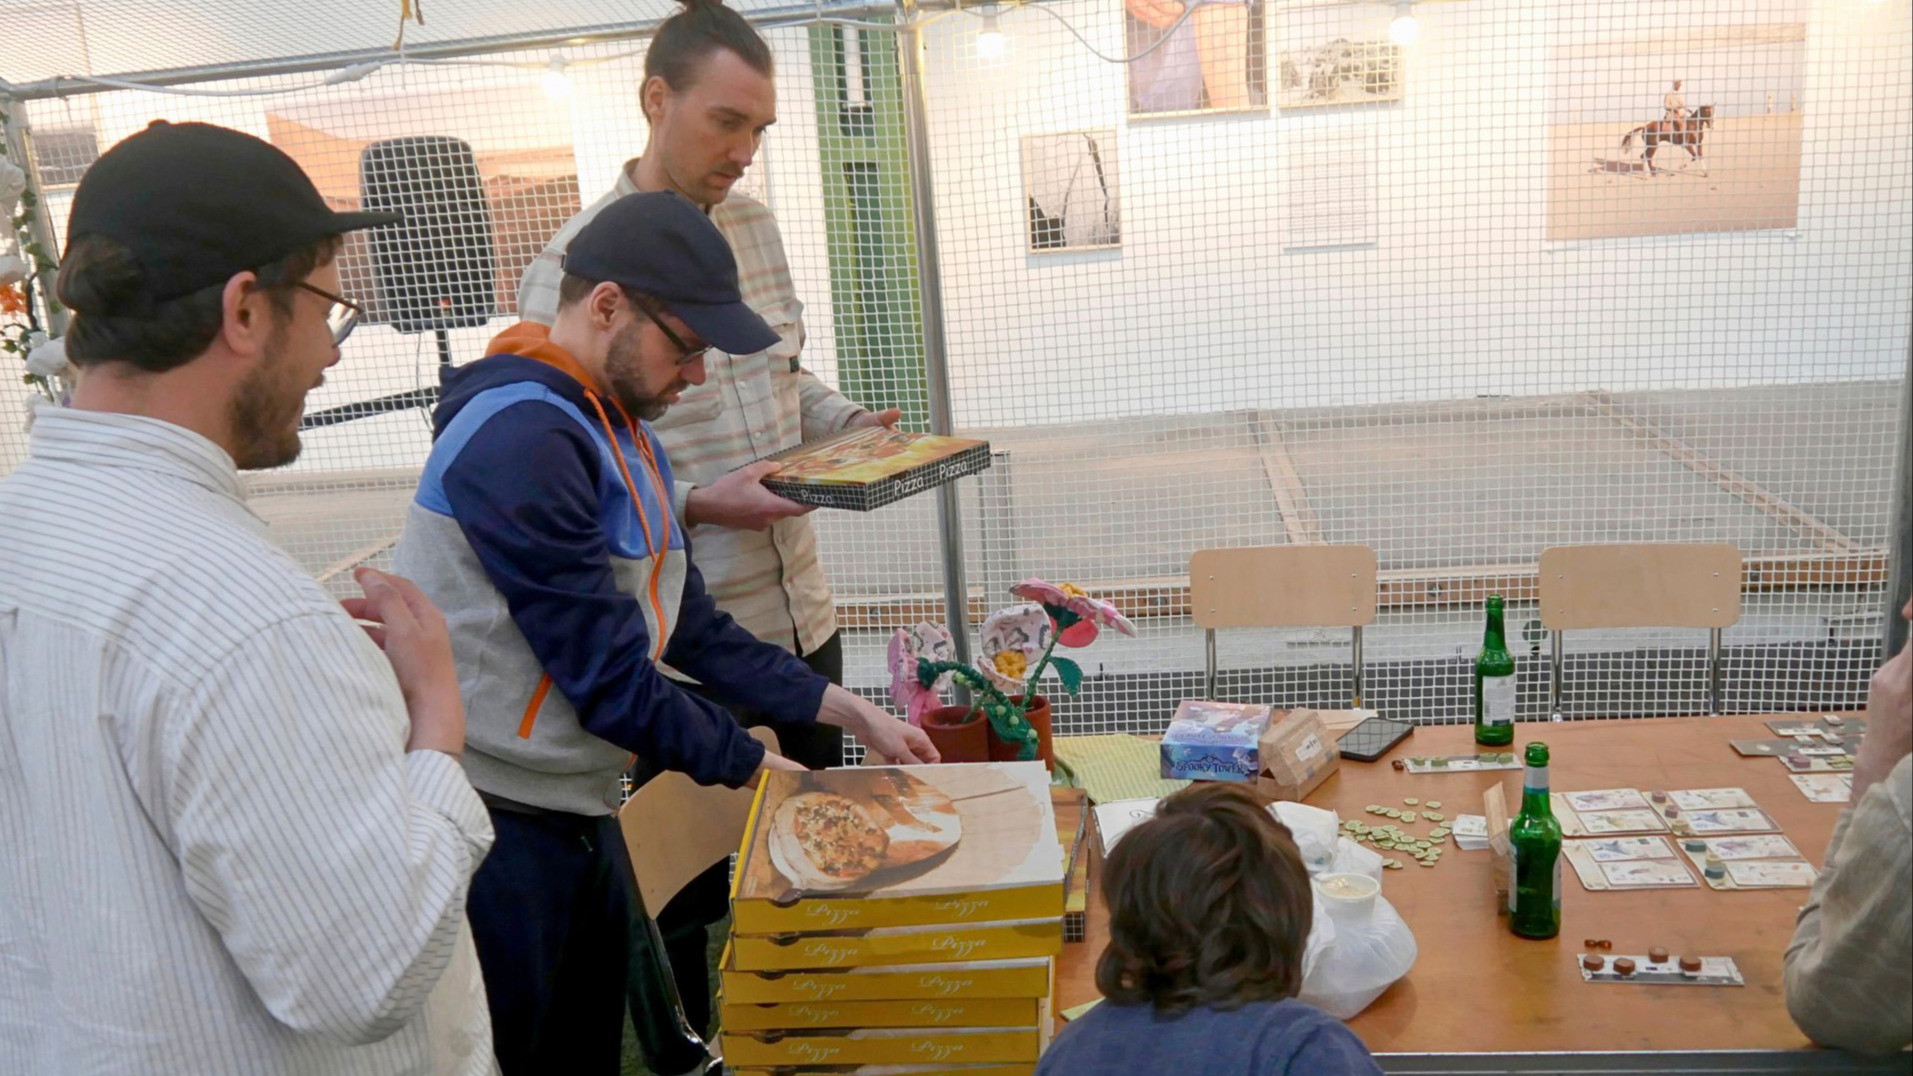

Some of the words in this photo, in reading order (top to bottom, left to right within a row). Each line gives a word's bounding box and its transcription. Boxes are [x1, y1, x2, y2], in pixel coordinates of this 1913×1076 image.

[894, 475, 924, 496] Pizza
[939, 459, 968, 480] Pizza
[801, 489, 834, 504] Pizza
[1176, 760, 1211, 773] SPOOKY
[1212, 761, 1246, 775] TOWER
[806, 903, 861, 925] Pizza
[935, 900, 990, 918] Pizza
[804, 943, 859, 965] Pizza
[931, 936, 987, 958] Pizza
[792, 979, 847, 999] Pizza
[919, 976, 974, 995] Pizza
[788, 1005, 840, 1022] Pizza
[911, 1003, 965, 1022] Pizza
[788, 1042, 841, 1062] Pizza
[911, 1040, 965, 1060] Pizza
